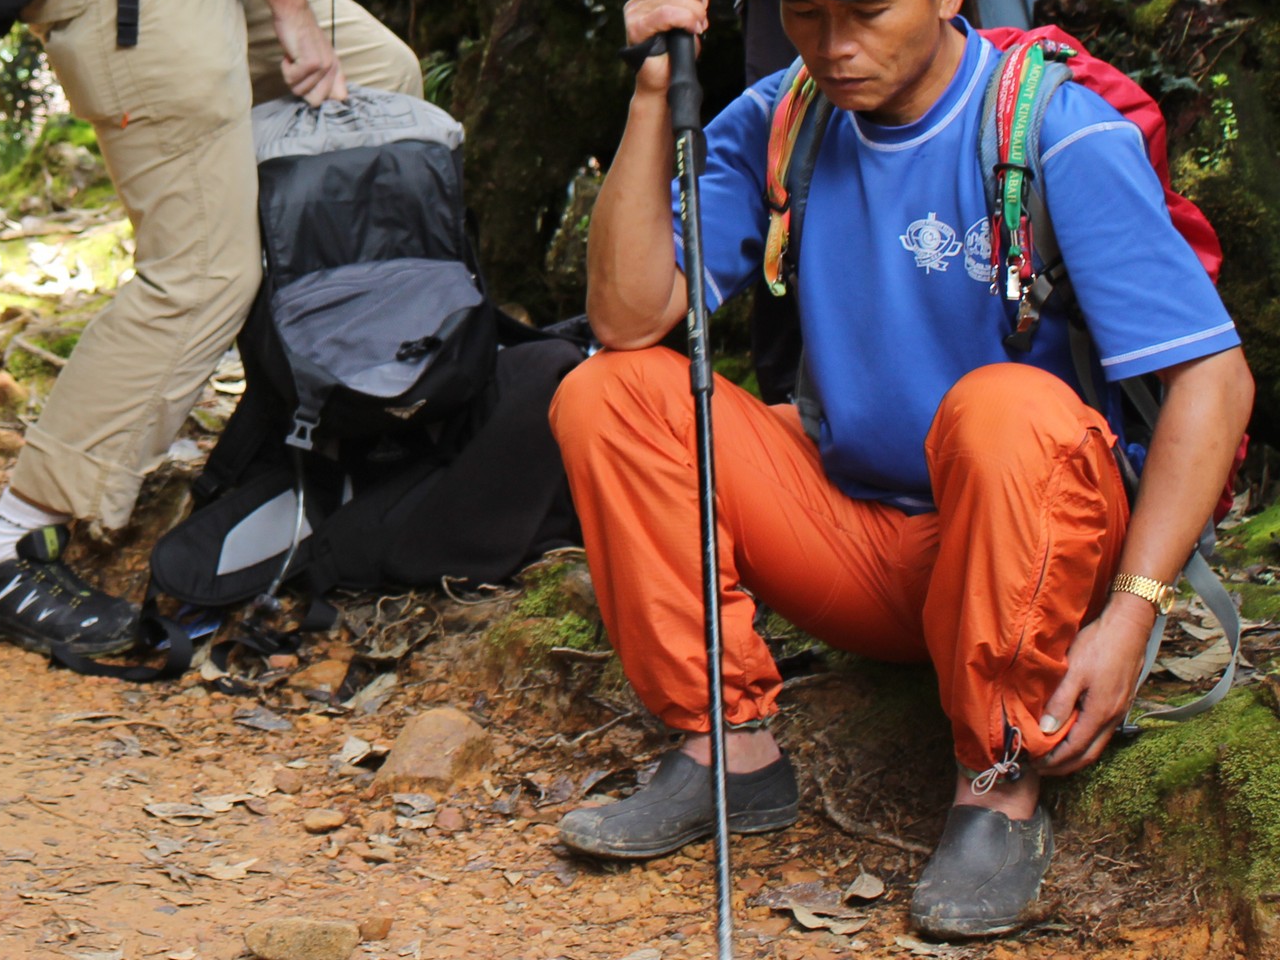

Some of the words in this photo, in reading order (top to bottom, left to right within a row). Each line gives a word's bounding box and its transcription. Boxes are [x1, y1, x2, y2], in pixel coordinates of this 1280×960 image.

[1021, 62, 1042, 100] MOUNT
[1010, 101, 1032, 161] KINABALU
[1006, 170, 1019, 204] ABAH
